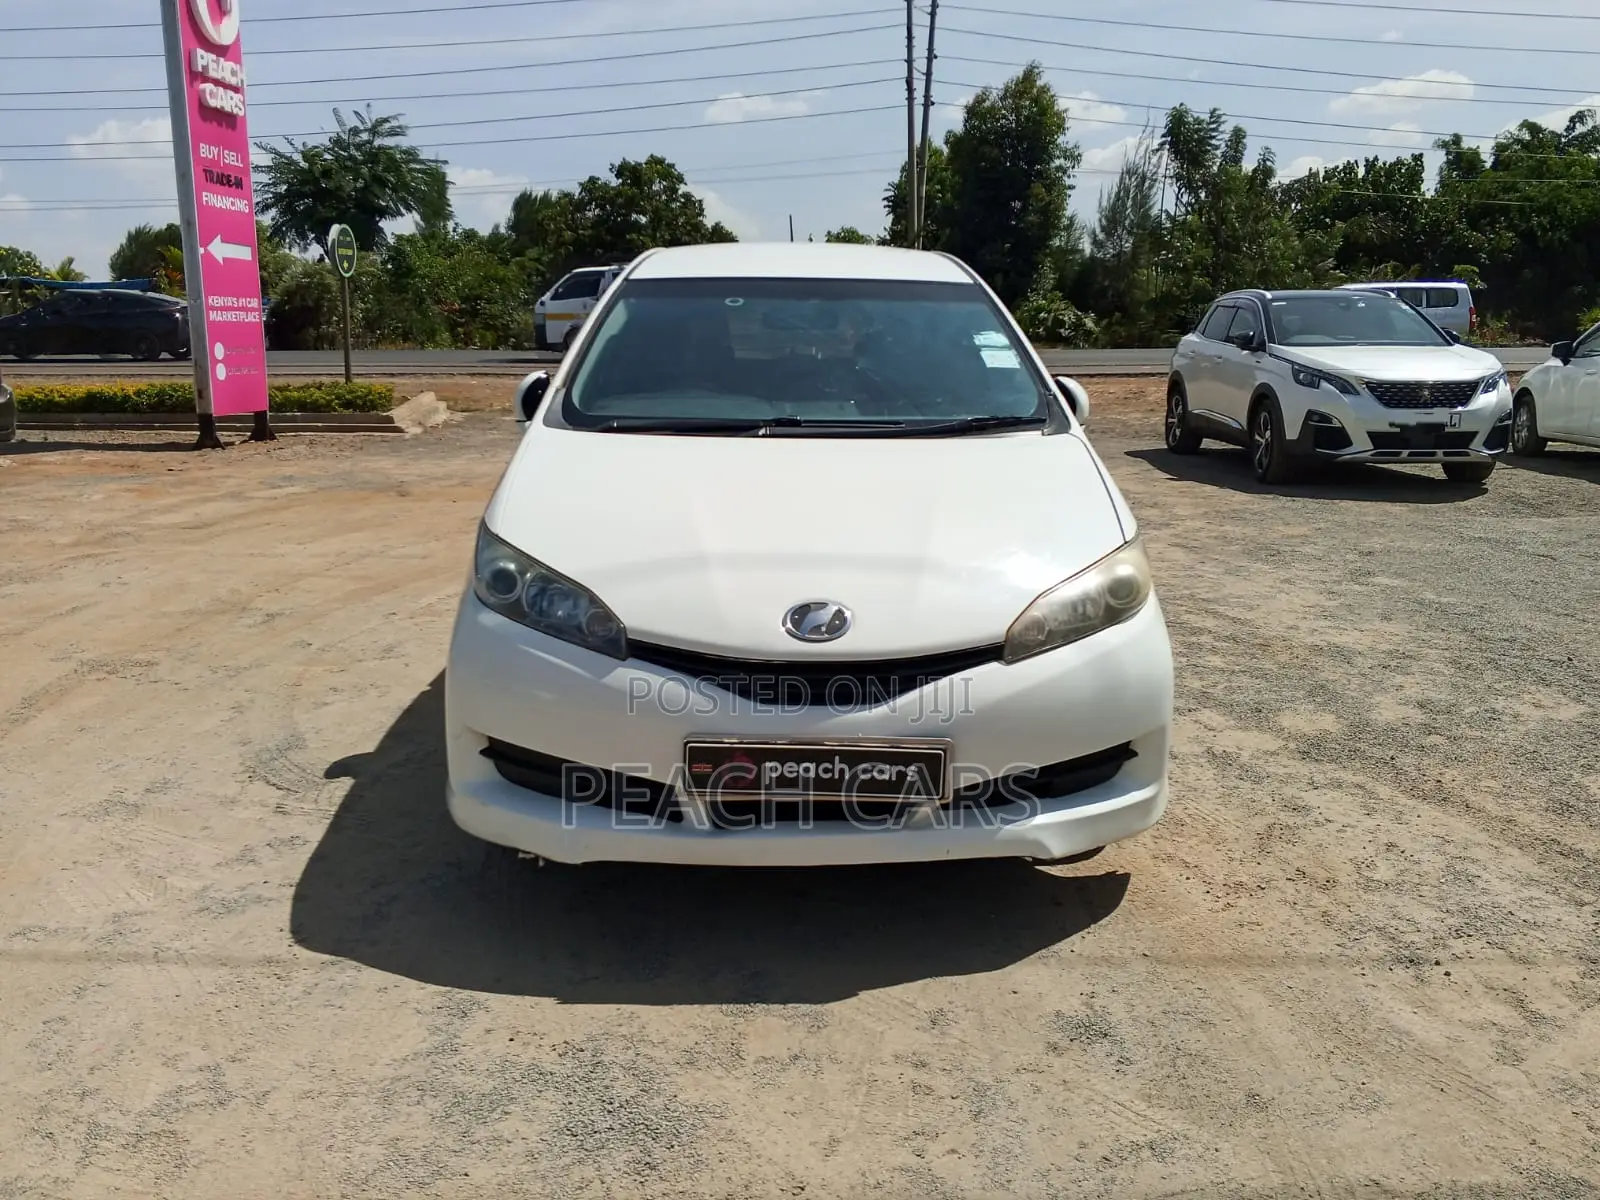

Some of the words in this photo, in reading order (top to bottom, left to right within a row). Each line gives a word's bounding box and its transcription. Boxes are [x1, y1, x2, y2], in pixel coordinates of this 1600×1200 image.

[190, 48, 246, 88] PEACH
[199, 83, 245, 117] CARS
[200, 143, 218, 160] BUY
[224, 150, 243, 167] SELL
[203, 192, 249, 213] FINANCING
[247, 298, 258, 308] CAR
[209, 310, 260, 322] MARKETPLACE
[765, 756, 849, 784] peach
[858, 762, 918, 781] cars
